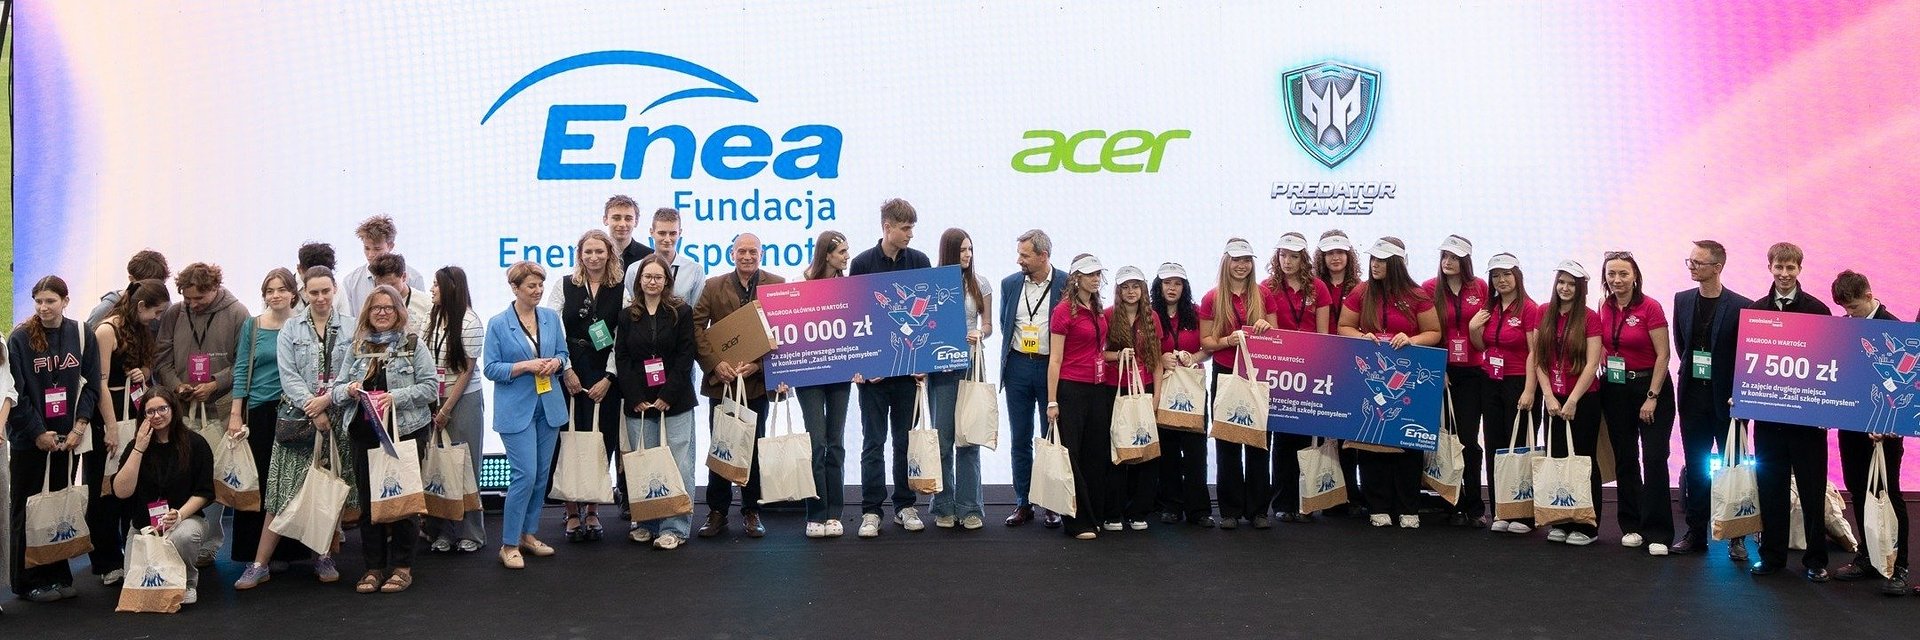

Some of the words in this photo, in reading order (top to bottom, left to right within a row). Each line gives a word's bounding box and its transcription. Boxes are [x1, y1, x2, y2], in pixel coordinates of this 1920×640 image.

[537, 104, 843, 180] Enea
[1010, 129, 1192, 173] acer
[1270, 181, 1397, 199] PREDATOR
[674, 188, 837, 230] Fundacja
[1289, 198, 1374, 216] GAMES
[767, 308, 792, 316] NAGRODA
[792, 306, 816, 314] GŁÓWNA
[821, 302, 849, 312] WARTOŚCI
[770, 323, 798, 345] 10
[804, 318, 847, 342] 000
[852, 314, 873, 337] zł
[722, 334, 740, 352] acer
[1778, 339, 1807, 348] WARTOŚCI
[778, 358, 808, 366] konkursie
[828, 354, 847, 362] szkołę
[780, 352, 800, 360] zajęcie
[802, 348, 836, 358] pierwszego
[836, 346, 859, 354] miejsca
[938, 350, 968, 360] Enea
[1278, 356, 1305, 364] WARTOŚCI
[34, 352, 80, 374] FILA
[1745, 353, 1759, 374] 7
[1764, 354, 1810, 380] 500
[1816, 360, 1838, 382] zł
[1266, 370, 1307, 392] 500
[1312, 374, 1334, 396] zł
[1750, 383, 1772, 391] zajęcie
[1773, 384, 1801, 394] drugiego
[1802, 388, 1827, 396] miejsca
[1272, 397, 1300, 406] trzeciego
[1300, 400, 1324, 408] miejsca
[1748, 390, 1778, 398] konkursie
[1800, 396, 1821, 404] szkołę
[52, 404, 60, 412] G
[1296, 407, 1317, 416] szkołę
[1405, 428, 1437, 440] Enea
